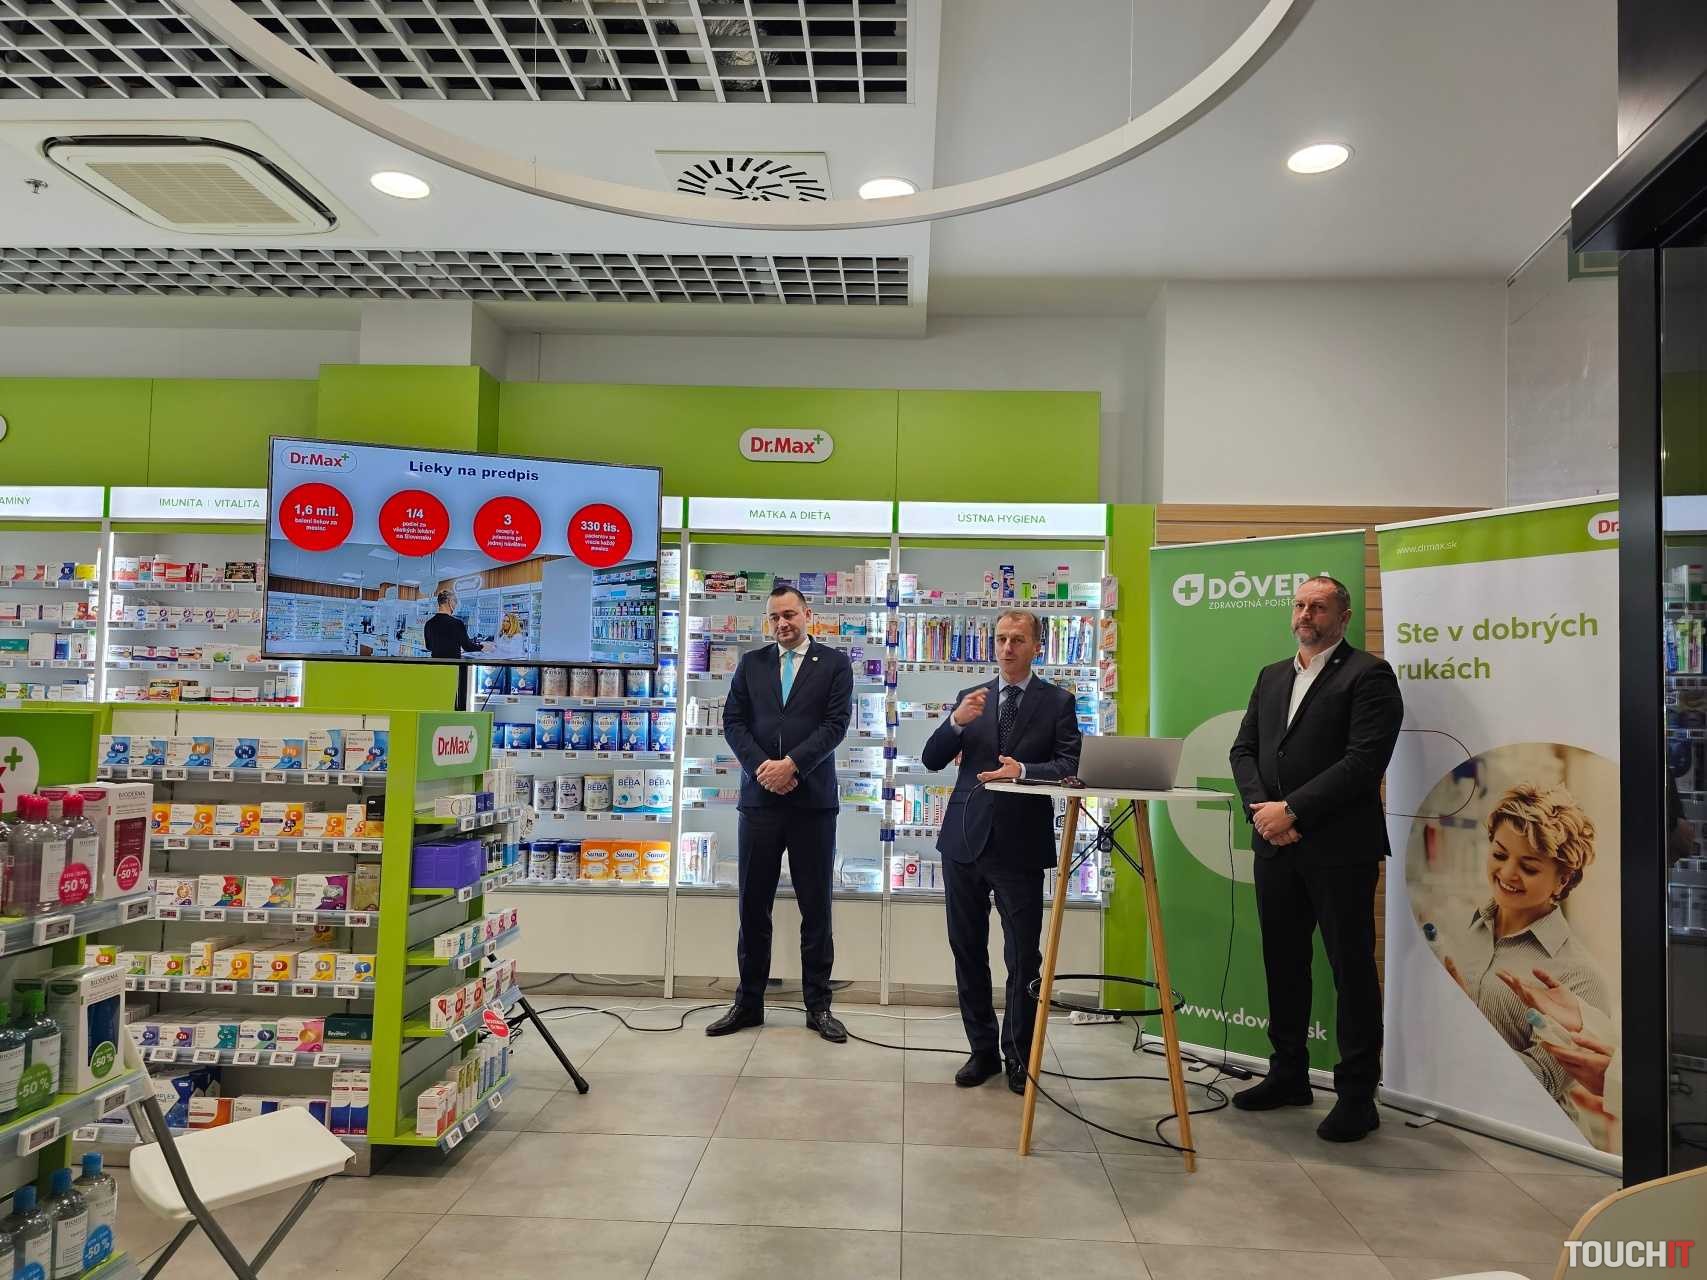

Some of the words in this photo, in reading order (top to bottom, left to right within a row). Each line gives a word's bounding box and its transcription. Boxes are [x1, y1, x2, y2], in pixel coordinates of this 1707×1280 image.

[750, 437, 815, 454] Dr.Max
[290, 452, 342, 467] Dr.Max
[409, 461, 453, 476] Lieky
[457, 466, 476, 477] na
[482, 469, 539, 482] predpis
[159, 498, 203, 507] IMUNITA
[214, 499, 260, 508] VITALITA
[294, 504, 313, 516] 1,6
[316, 506, 339, 517] mil.
[406, 508, 424, 519] 1/4
[749, 510, 786, 519] MATKA
[790, 511, 797, 519] A
[503, 514, 512, 525] 3
[997, 514, 1046, 523] HYGIENA
[580, 520, 600, 532] 330
[602, 522, 620, 533] tis.
[1396, 540, 1457, 554] www.drmax.sk
[1208, 571, 1330, 600] DÔVER
[1208, 598, 1262, 610] ZDRAVOTNÁ
[1396, 622, 1439, 644] Ste
[1448, 625, 1464, 642] v
[1472, 613, 1598, 645] dobrých
[1397, 656, 1491, 680] rukách
[437, 736, 470, 756] Dr.Max
[587, 783, 608, 791] BEBA
[618, 778, 640, 786] BEBA
[649, 778, 672, 786] BEBA
[586, 850, 607, 858] Sunar
[616, 850, 636, 858] Sunar
[118, 868, 130, 879] -50
[60, 879, 78, 892] -50
[80, 878, 88, 890] %
[19, 1082, 38, 1099] -50
